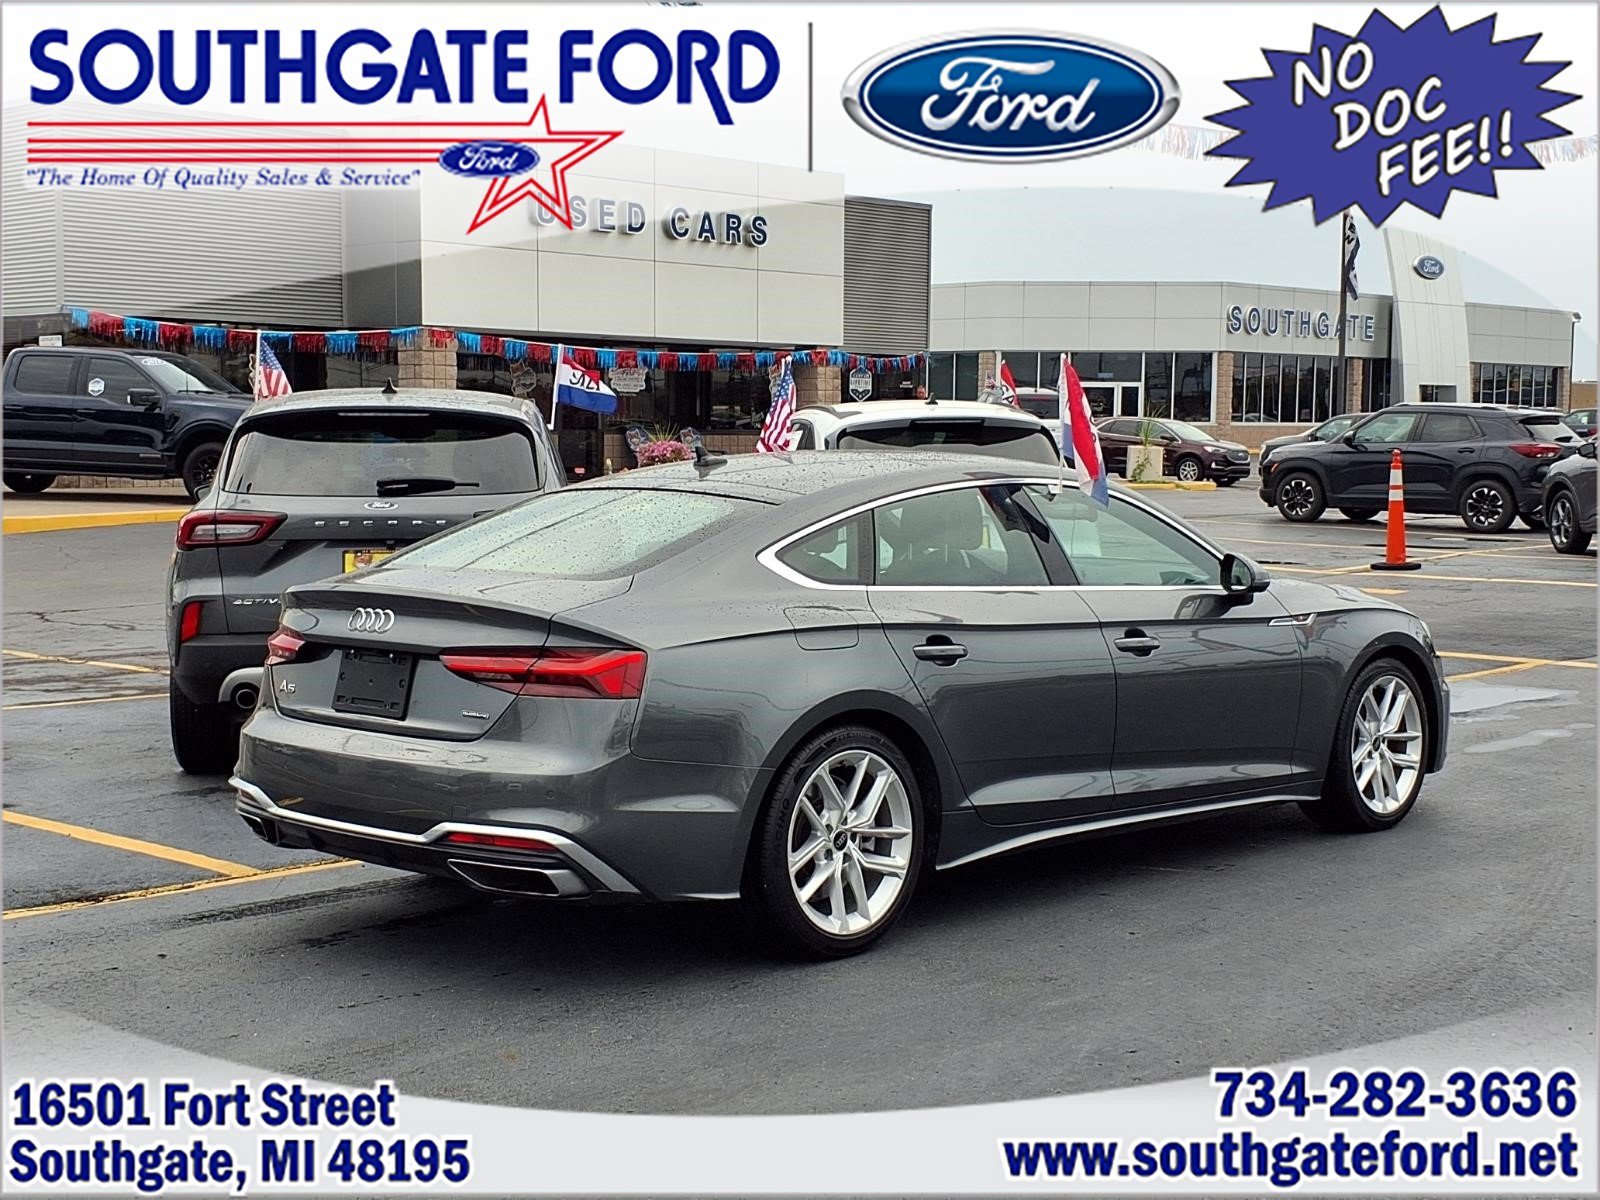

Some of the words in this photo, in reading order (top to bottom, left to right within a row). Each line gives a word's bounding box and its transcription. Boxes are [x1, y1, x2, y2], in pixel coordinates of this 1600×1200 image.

[533, 192, 647, 236] USED
[668, 206, 769, 247] CARS
[1423, 259, 1441, 274] Ford
[232, 598, 282, 606] ACTIV
[279, 679, 297, 694] A5
